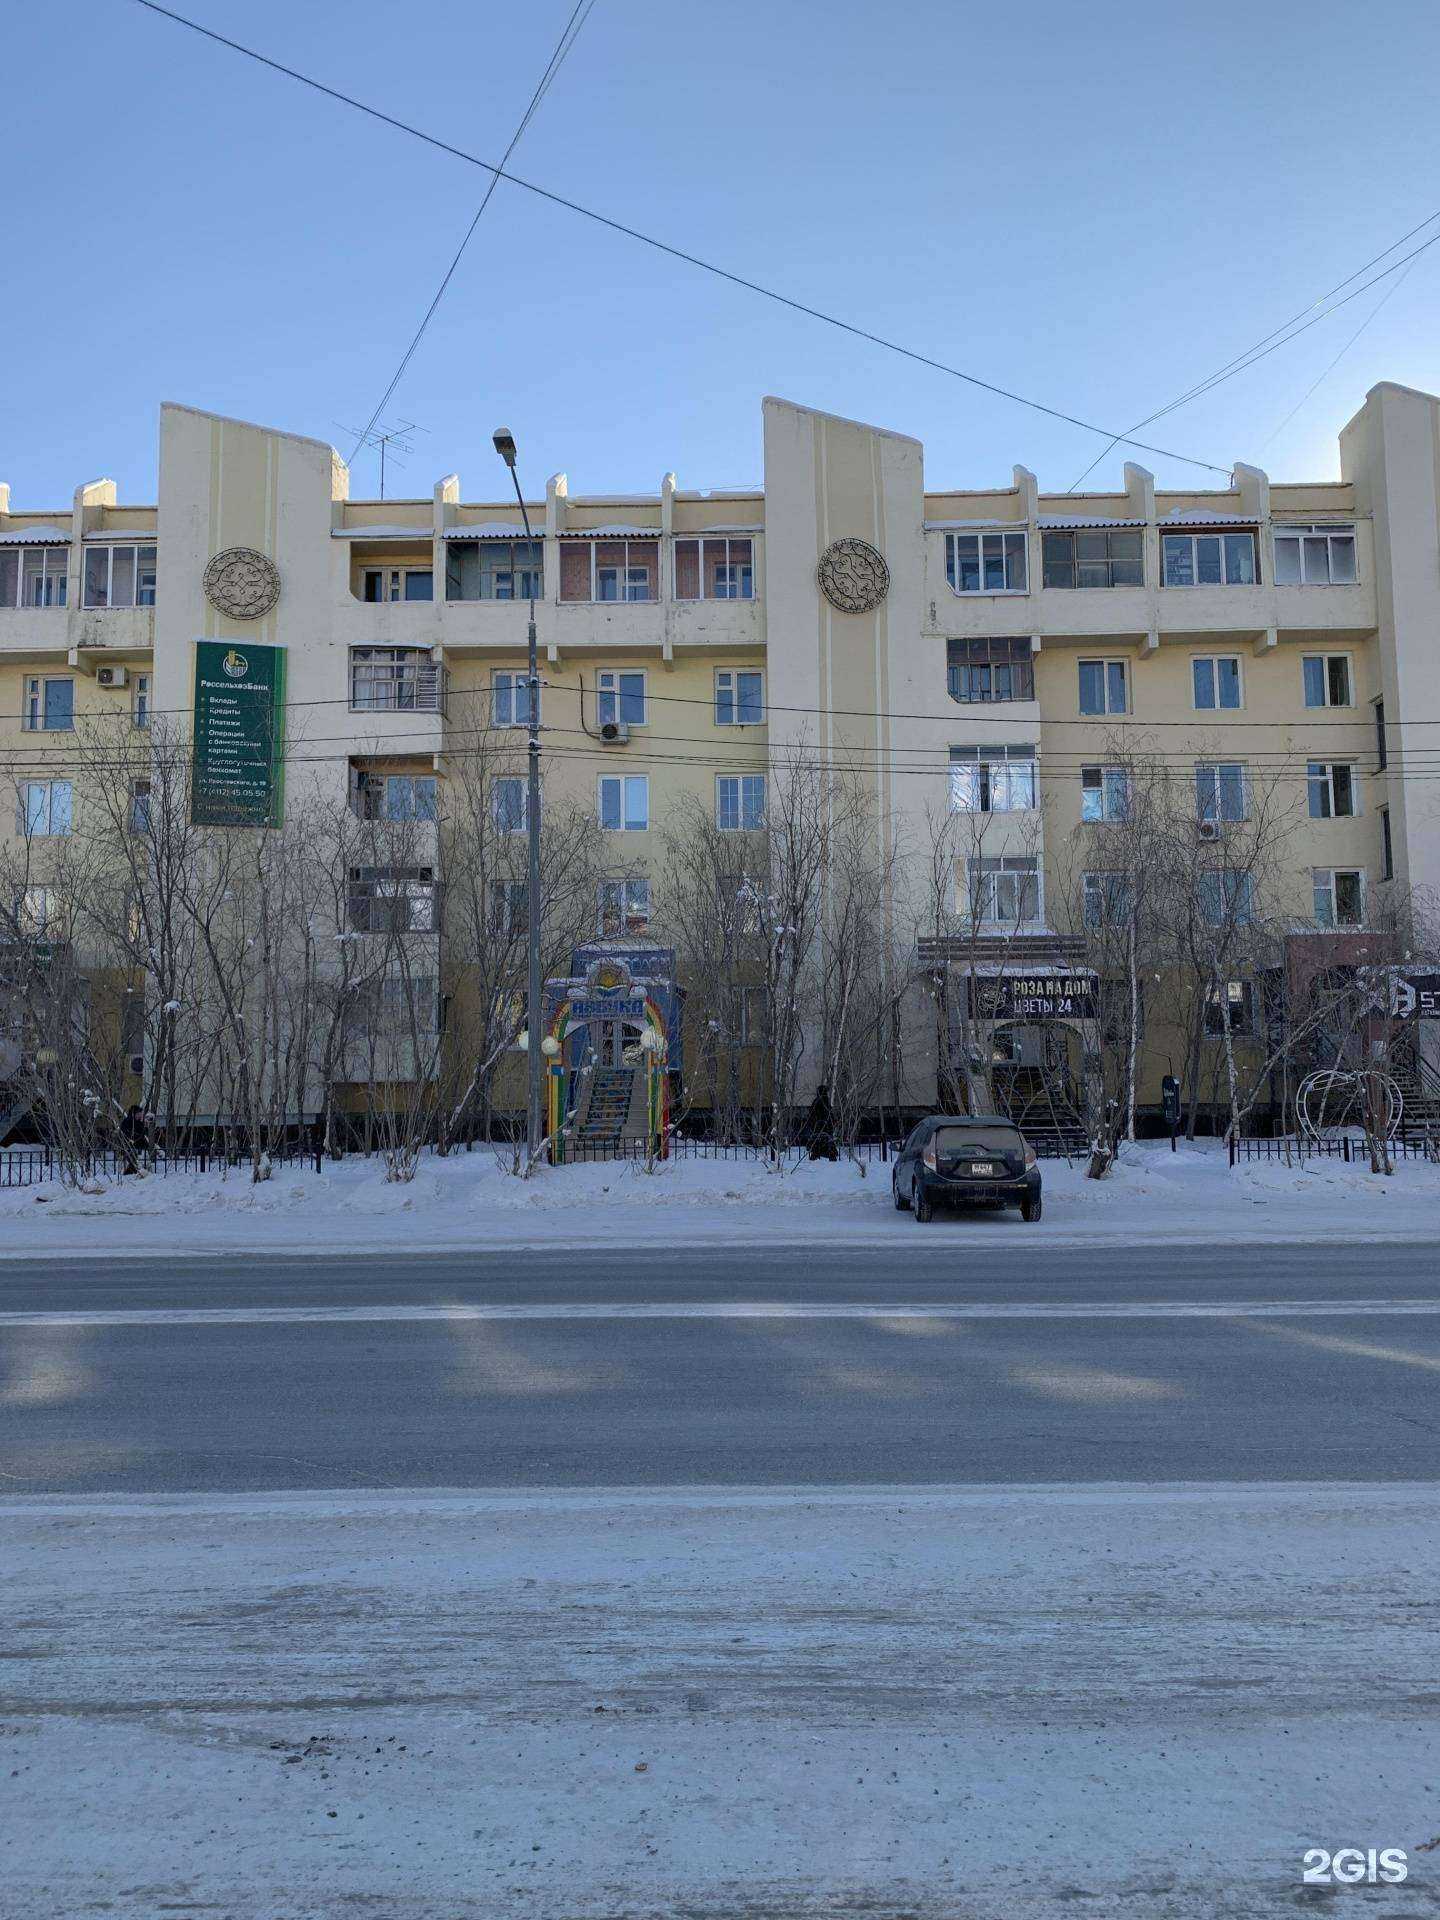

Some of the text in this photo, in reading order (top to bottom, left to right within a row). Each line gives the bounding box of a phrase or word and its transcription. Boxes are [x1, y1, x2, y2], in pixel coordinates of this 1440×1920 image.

[209, 696, 238, 704] Вклады
[208, 729, 245, 737] Операции
[1013, 980, 1092, 996] РОЗА НА ДОМ
[1014, 998, 1072, 1013] ЦВЕТЫ 24
